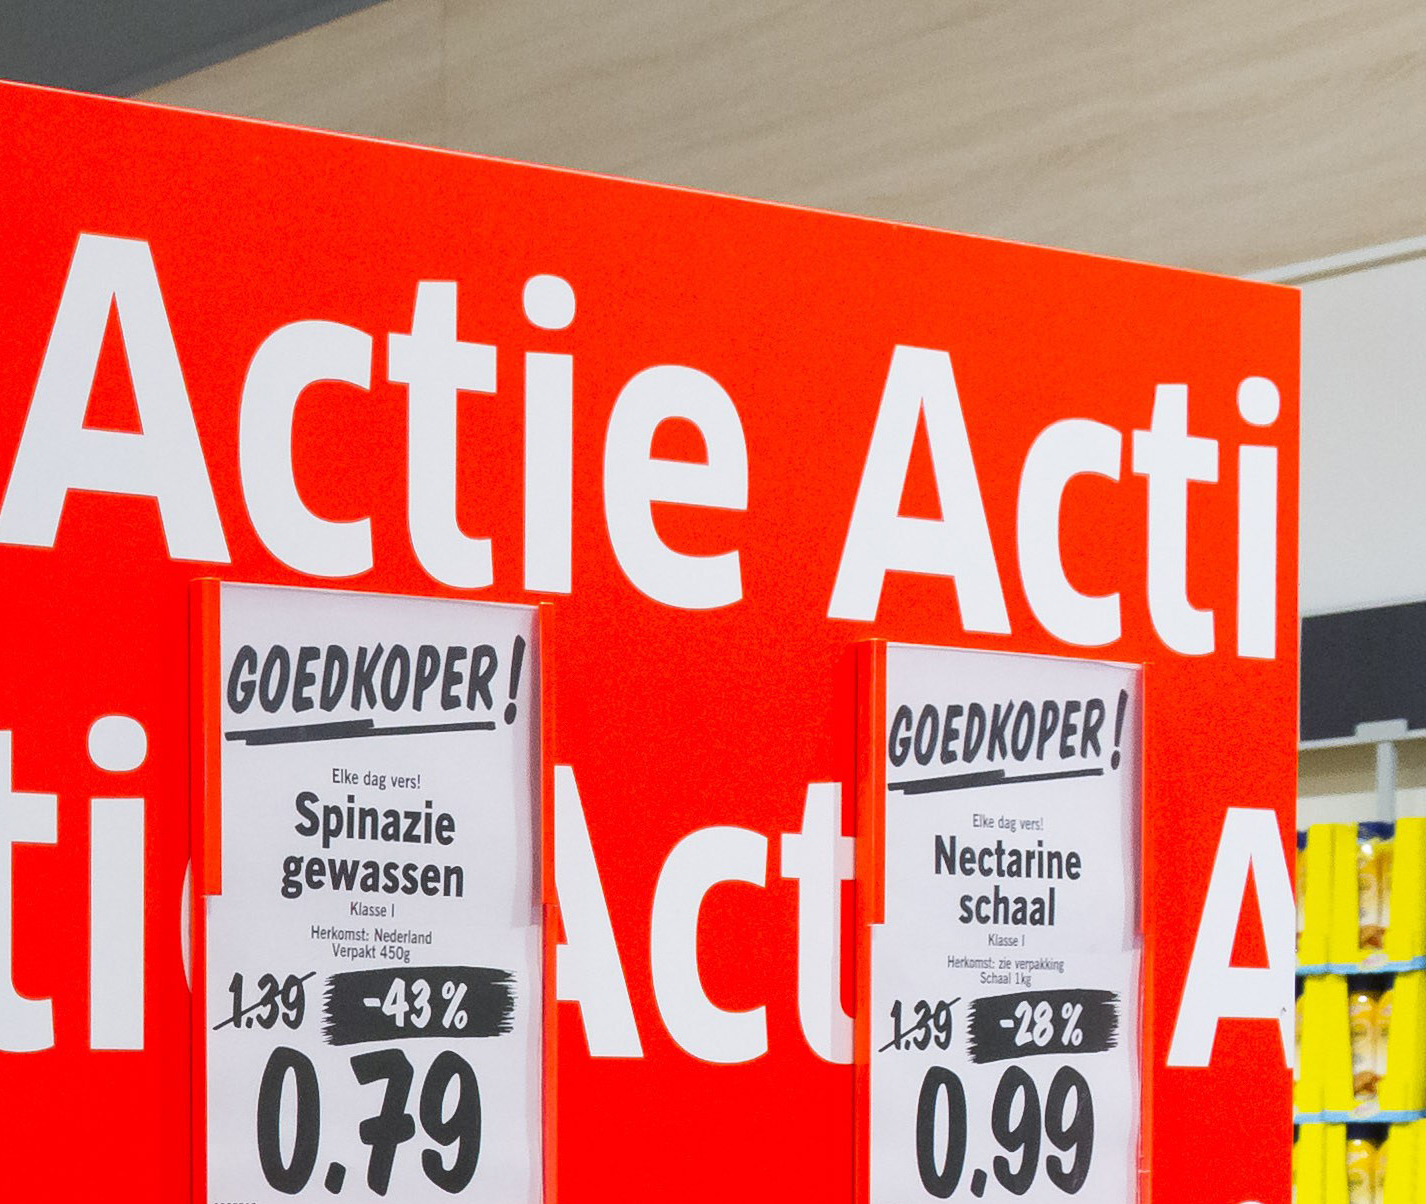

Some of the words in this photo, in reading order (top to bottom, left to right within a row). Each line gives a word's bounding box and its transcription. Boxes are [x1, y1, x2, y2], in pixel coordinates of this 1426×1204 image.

[827, 345, 1281, 660] Acti
[226, 634, 526, 726] GOEDKOPER!
[888, 688, 1129, 771] GOEDKOPER!
[332, 768, 360, 786] Elke
[363, 770, 387, 790] dag
[390, 774, 422, 790] vers!
[294, 791, 456, 849] Spinazie
[973, 813, 996, 829] Elke
[998, 815, 1017, 833] dag
[1019, 817, 1045, 831] vers!
[281, 855, 465, 900] gewassen
[934, 834, 1083, 880] Nectarine
[350, 901, 387, 917] Klasse
[958, 885, 1055, 926] schaal
[310, 925, 370, 942] Herkomst:
[374, 928, 433, 945] Nederland
[332, 943, 377, 961] Verpakt
[379, 946, 411, 964] 450g
[988, 933, 1019, 948] Klasse
[947, 955, 996, 969] Herkomst:
[998, 957, 1012, 971] zie
[1014, 958, 1065, 974] verpakking
[980, 971, 1011, 985] Schaal
[1015, 972, 1032, 987] 1kg
[228, 971, 306, 1030] 1.39
[890, 998, 954, 1051] 1.39
[257, 1046, 483, 1197] 0.79
[915, 1065, 1096, 1200] 0.99
